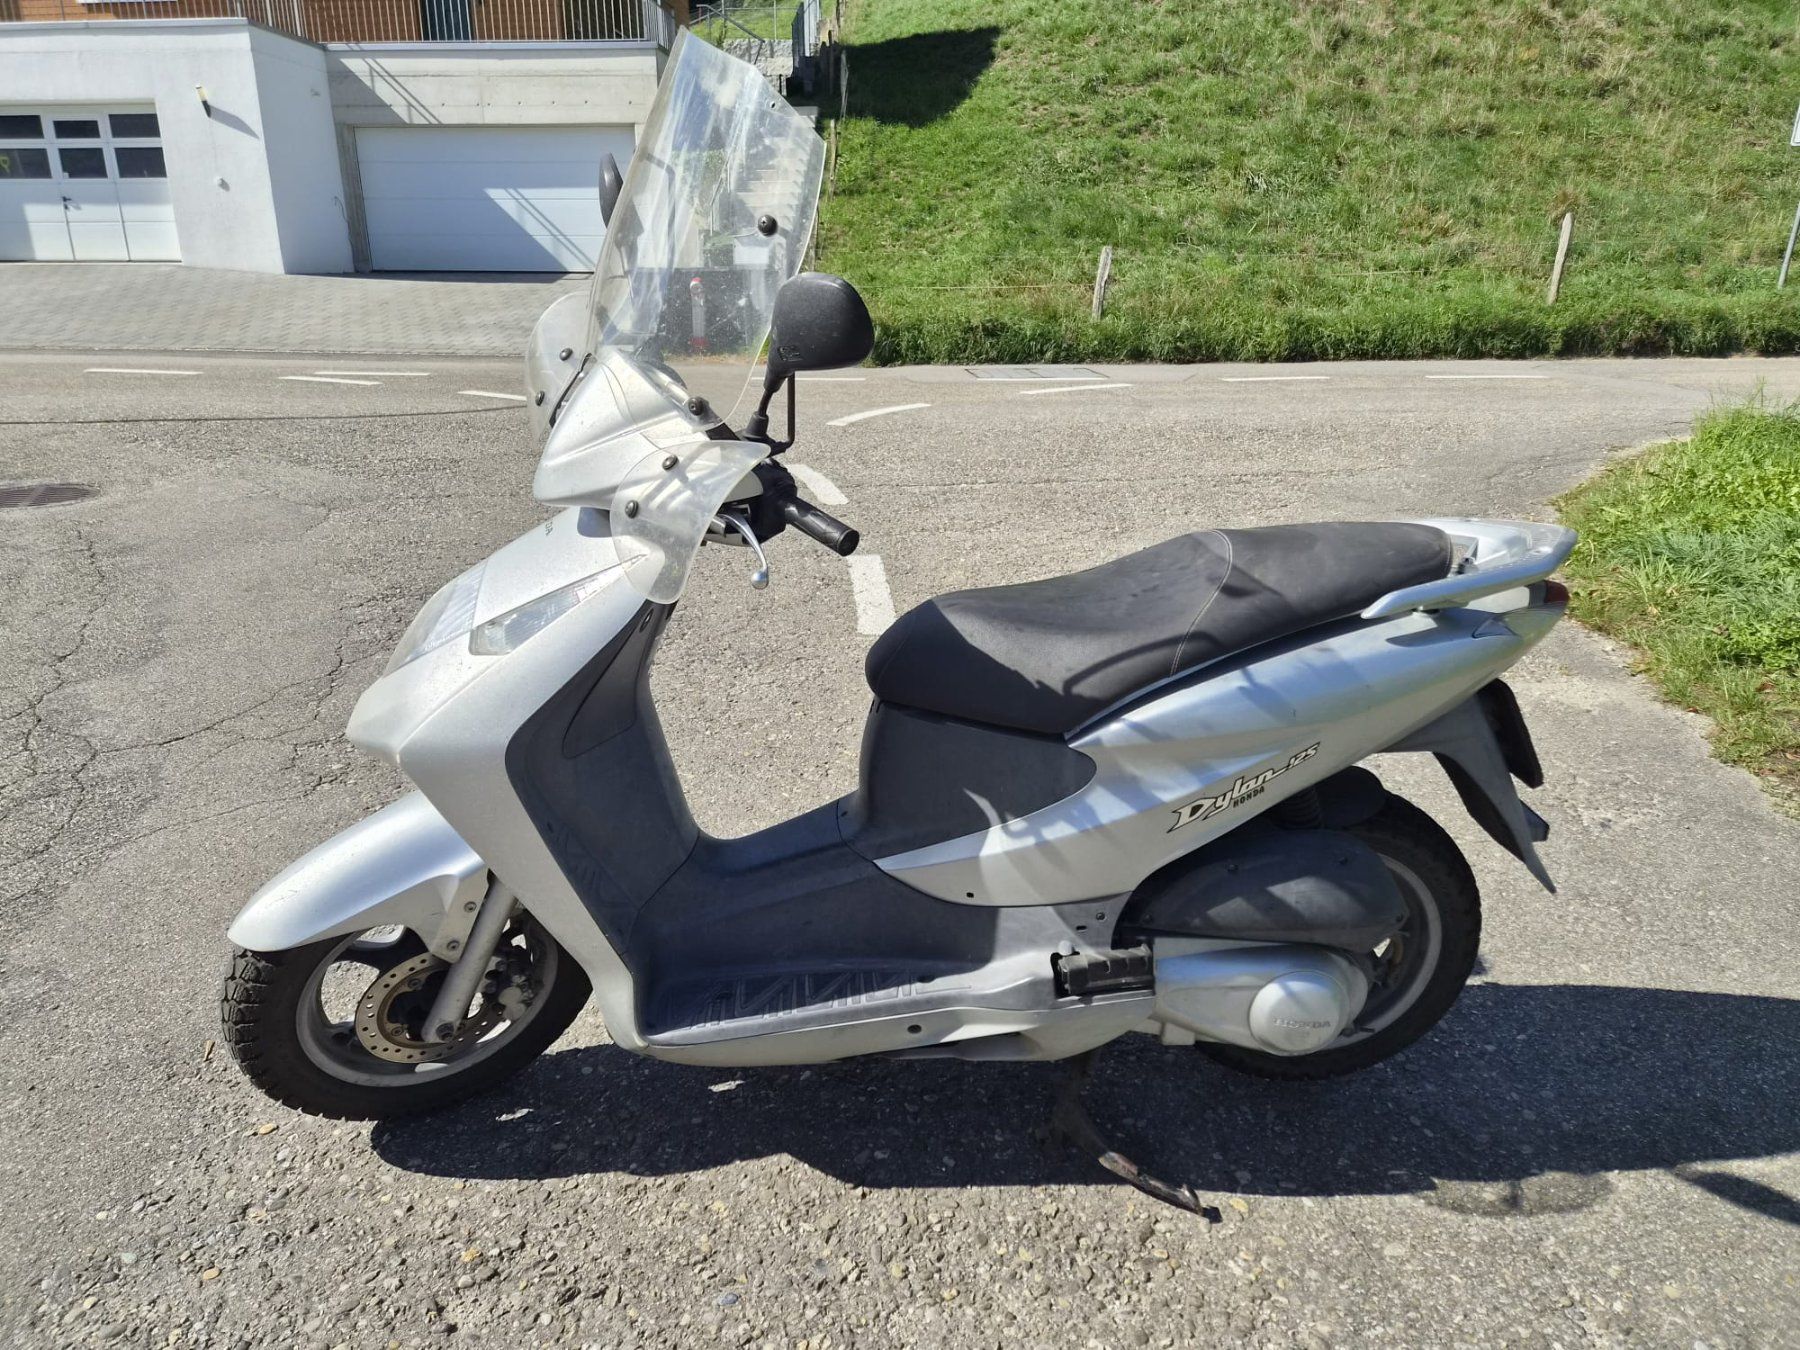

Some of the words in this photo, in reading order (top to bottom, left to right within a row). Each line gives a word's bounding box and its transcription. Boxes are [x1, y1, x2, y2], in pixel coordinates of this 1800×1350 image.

[1167, 766, 1287, 833] Dylan
[1286, 742, 1320, 769] 125
[1233, 786, 1265, 808] HONDA
[1273, 1018, 1331, 1029] HONDA
